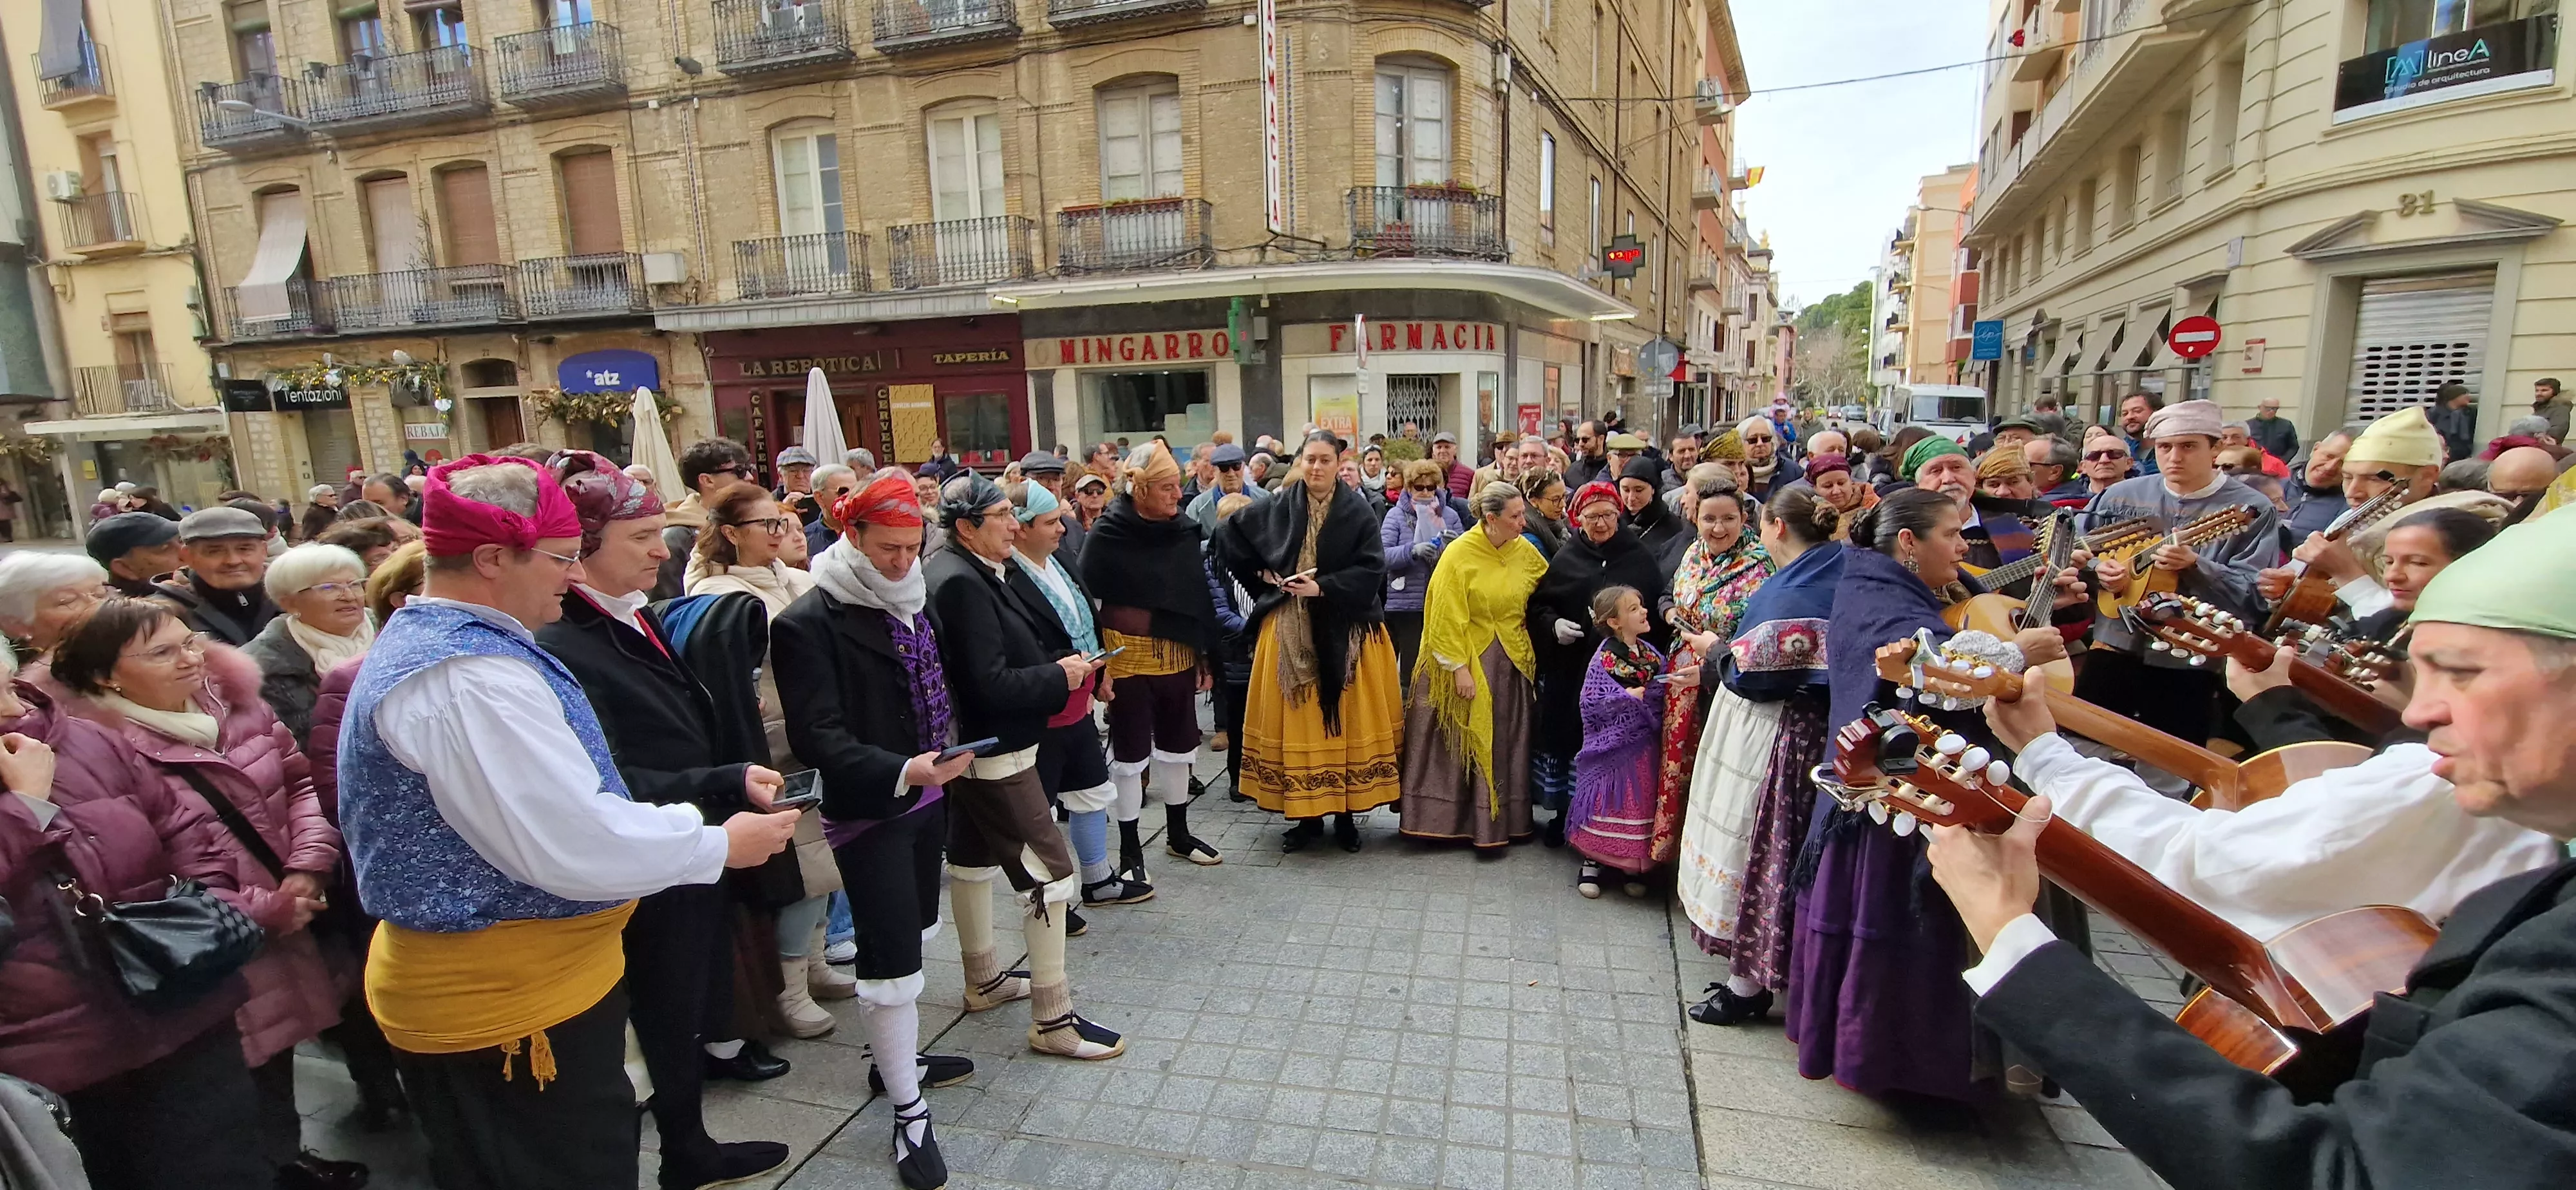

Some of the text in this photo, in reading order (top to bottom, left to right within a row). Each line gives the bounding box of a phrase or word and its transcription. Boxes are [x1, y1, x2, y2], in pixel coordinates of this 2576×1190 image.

[2427, 38, 2490, 67] lineA
[2384, 67, 2491, 94] Estudio de arquitectura
[933, 348, 1010, 364] TAPERÍA
[1059, 331, 1230, 364] MINGARRO
[739, 356, 876, 376] LA REBOTICA
[283, 388, 343, 403] Tentazioni
[1320, 416, 1352, 430] EXTRA
